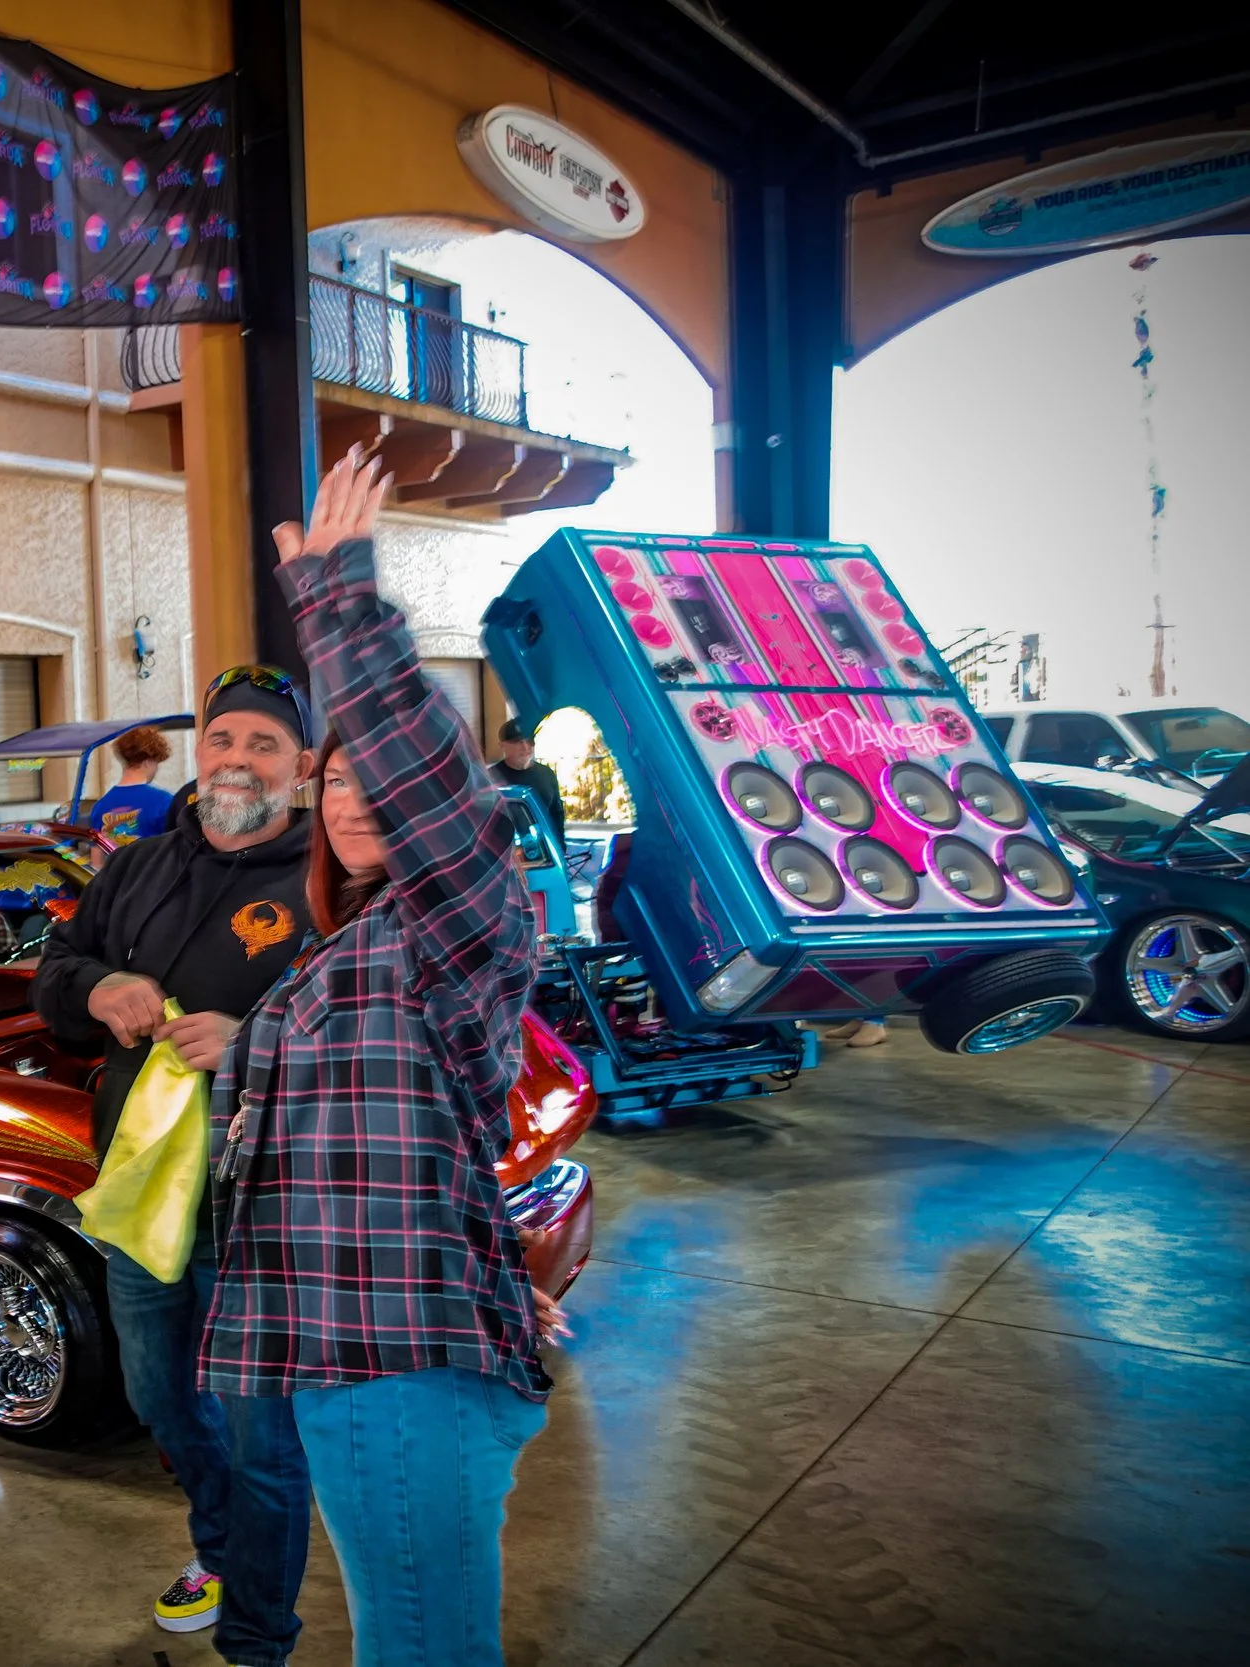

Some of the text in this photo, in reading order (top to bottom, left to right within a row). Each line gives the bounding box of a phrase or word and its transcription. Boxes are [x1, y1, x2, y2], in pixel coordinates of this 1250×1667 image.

[506, 125, 555, 178] COWBOY
[1034, 190, 1075, 211] YOUR
[1121, 169, 1165, 193] YOUR
[1167, 150, 1250, 182] DESTINAT
[733, 706, 956, 756] NASTY DANCER
